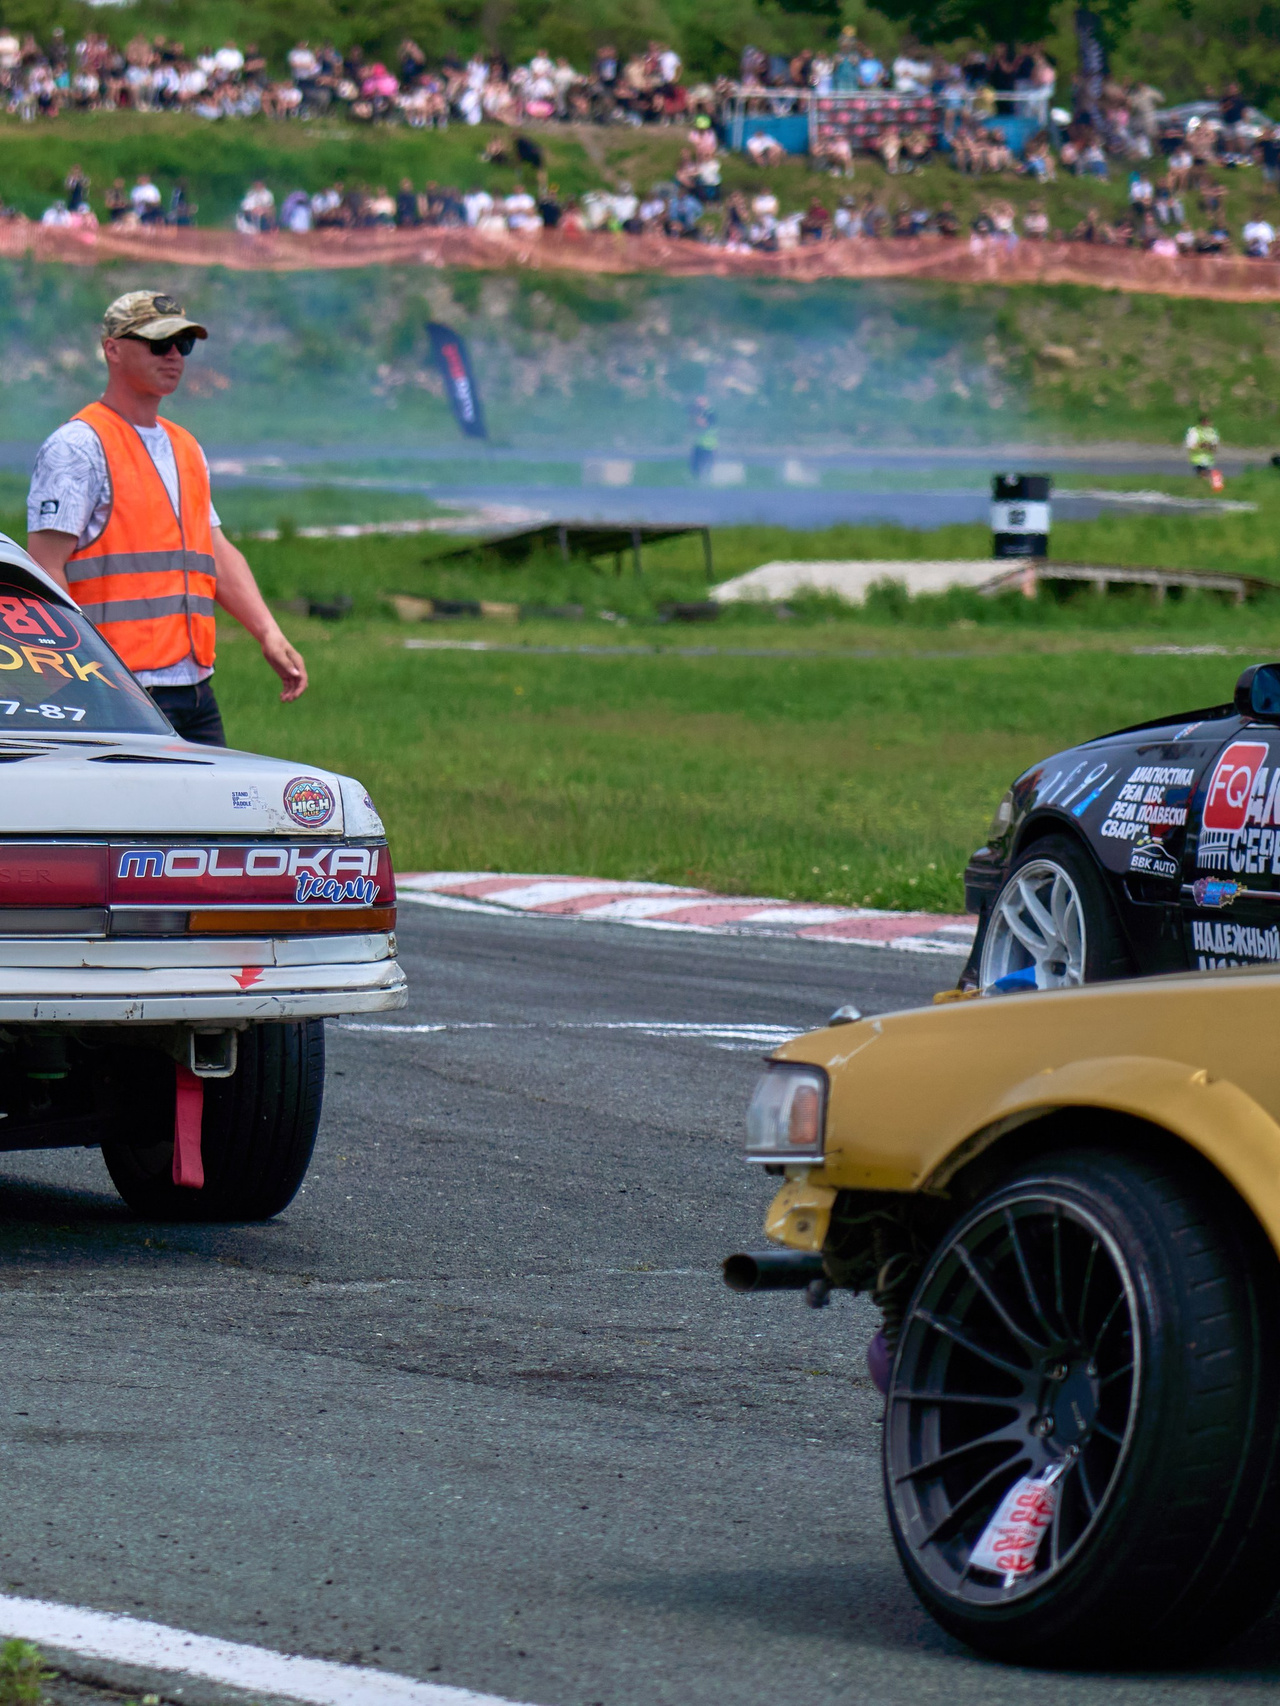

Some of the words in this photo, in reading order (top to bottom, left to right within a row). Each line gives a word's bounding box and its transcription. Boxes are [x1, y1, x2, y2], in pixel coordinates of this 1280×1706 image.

[1127, 766, 1195, 786] ДИАГНОСТИКА
[1209, 764, 1251, 808] FQ
[1118, 784, 1144, 802] РЕМ
[1142, 785, 1166, 804] ДВС
[1108, 800, 1137, 821] РЕМ
[1136, 804, 1187, 826] ПОДВЕСКИ
[117, 849, 379, 878] MOLOKAI
[1153, 860, 1177, 874] AUTO
[295, 871, 380, 904] team
[1193, 920, 1280, 960] НАДЕЖНЫЙ
